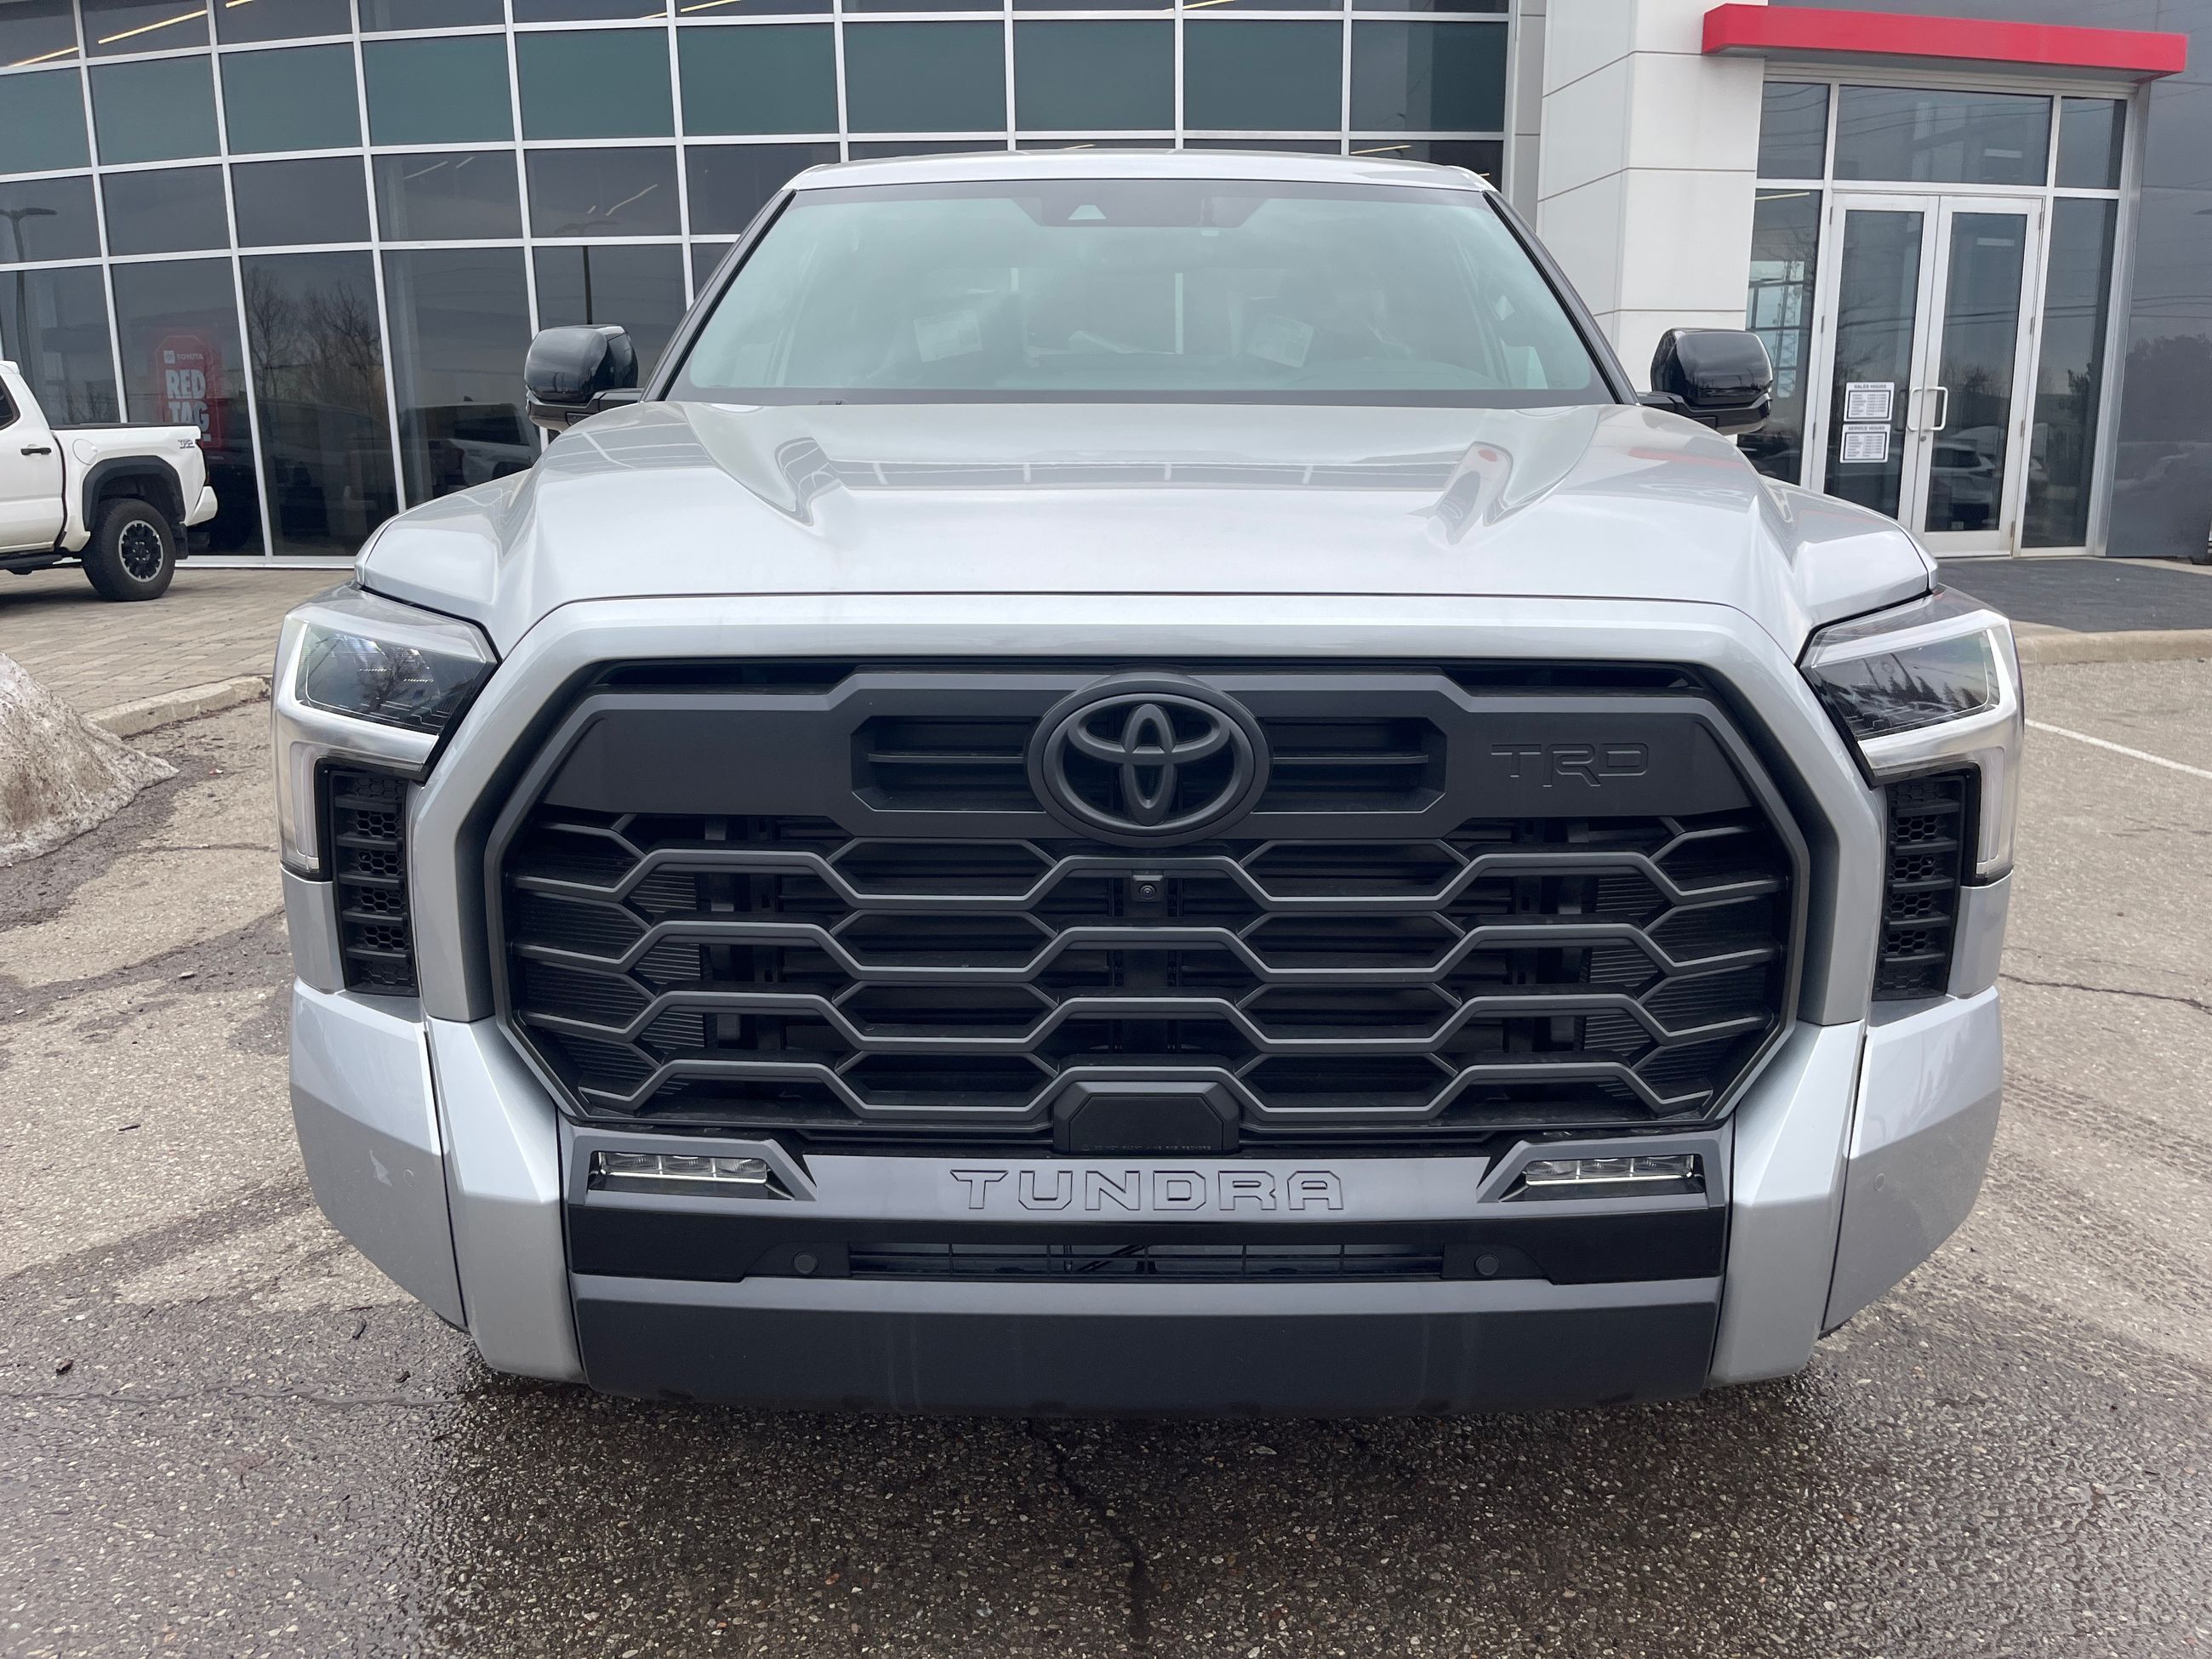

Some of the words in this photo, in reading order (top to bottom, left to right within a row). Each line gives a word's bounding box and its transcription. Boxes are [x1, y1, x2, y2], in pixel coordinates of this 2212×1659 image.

[165, 368, 206, 399] RED
[168, 401, 210, 432] TAG
[1491, 742, 1649, 788] TRD
[949, 1169, 1344, 1211] TUNDRA
